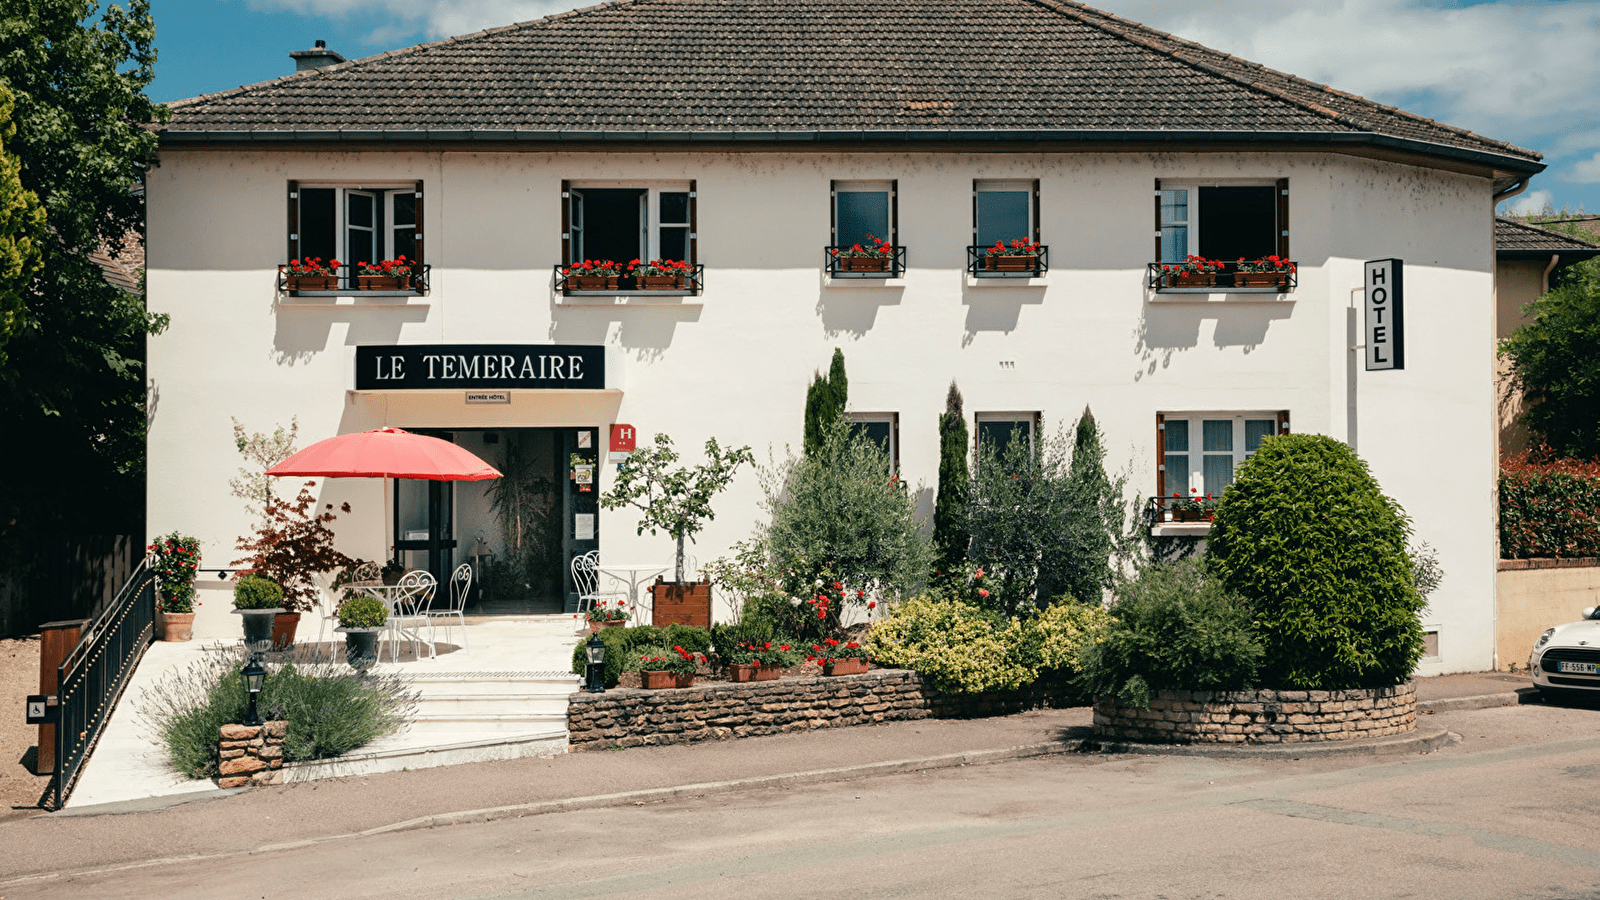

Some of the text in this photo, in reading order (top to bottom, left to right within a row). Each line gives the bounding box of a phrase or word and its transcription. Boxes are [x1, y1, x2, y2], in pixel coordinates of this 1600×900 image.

[1371, 267, 1388, 364] HOTEL
[375, 354, 584, 380] LE TEMERAIRE
[620, 428, 632, 440] H
